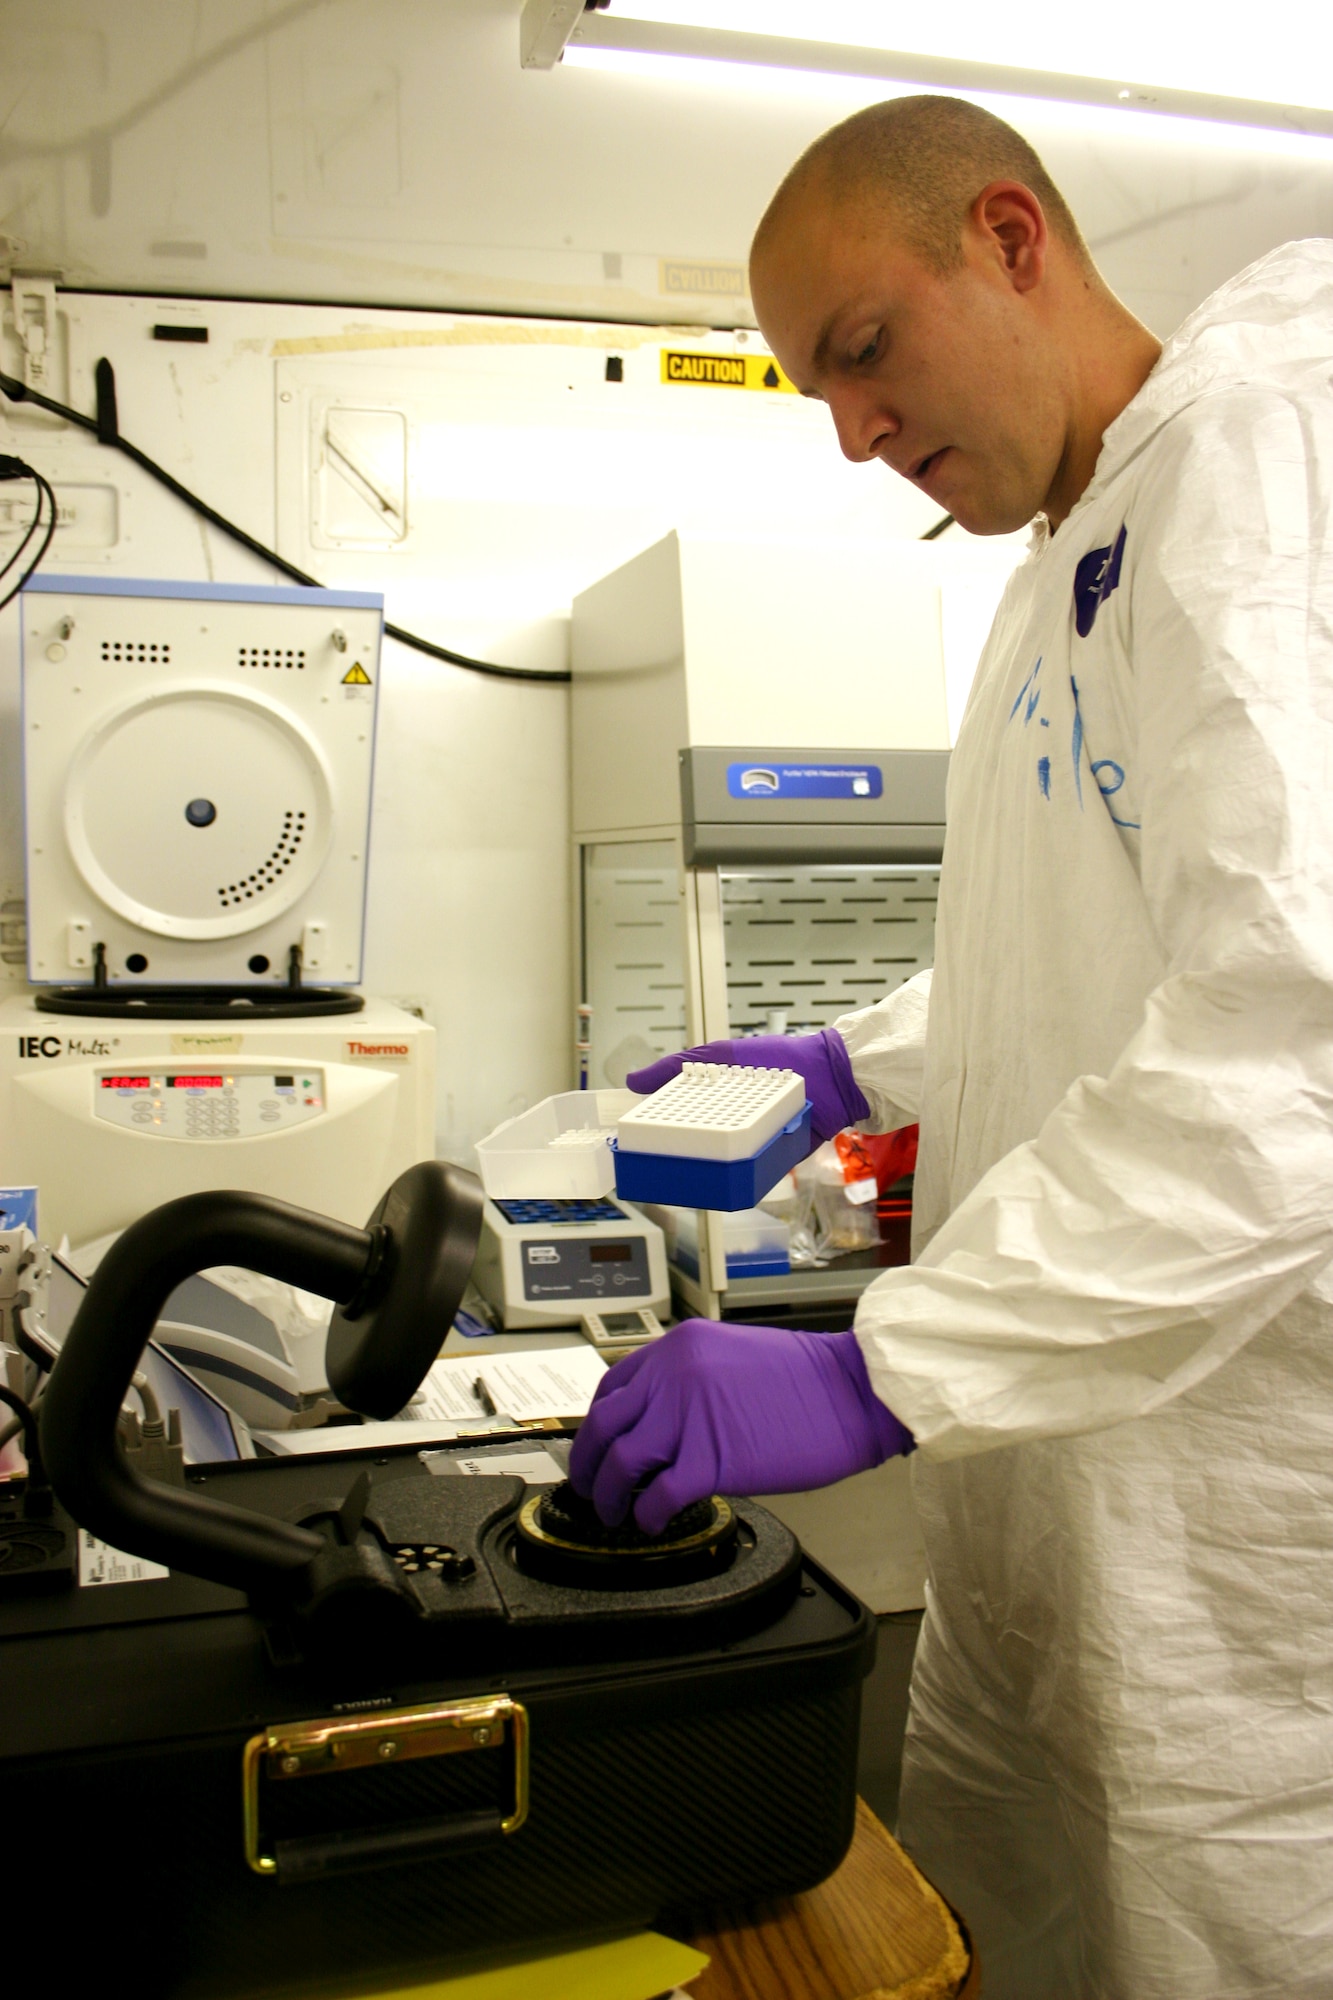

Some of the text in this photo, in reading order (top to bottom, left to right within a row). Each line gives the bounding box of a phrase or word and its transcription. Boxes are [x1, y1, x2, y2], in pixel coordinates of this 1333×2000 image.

[668, 355, 744, 383] CAUTION
[18, 1036, 61, 1058] IEC
[346, 1041, 408, 1056] Thermo
